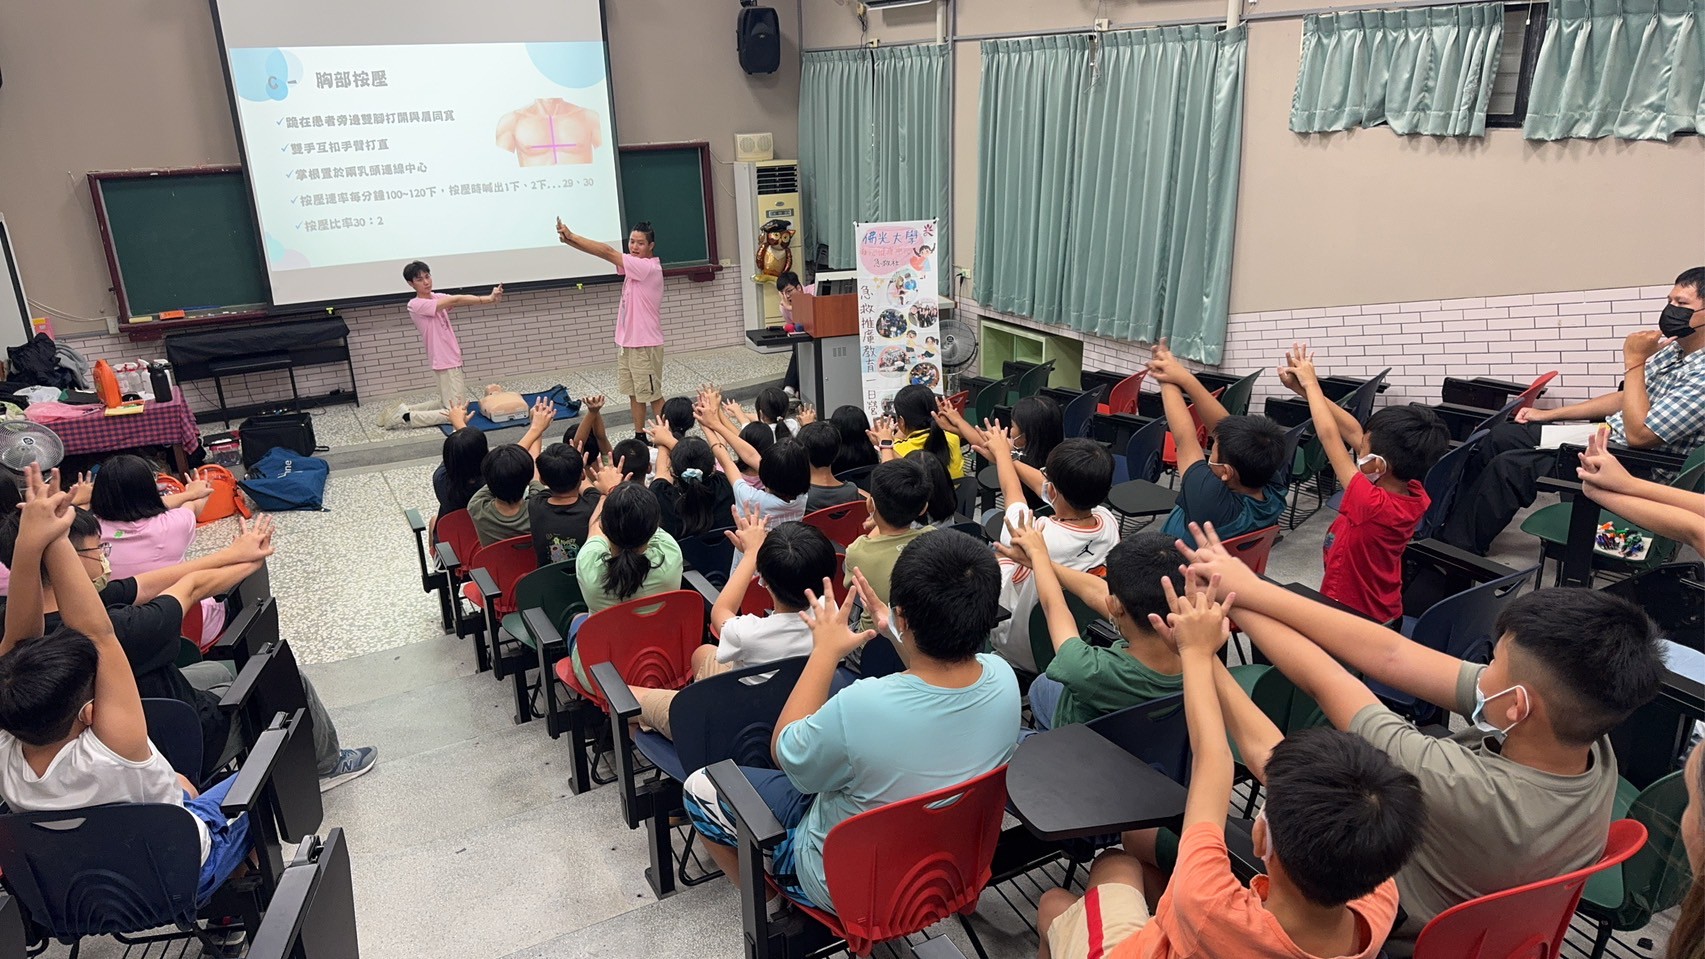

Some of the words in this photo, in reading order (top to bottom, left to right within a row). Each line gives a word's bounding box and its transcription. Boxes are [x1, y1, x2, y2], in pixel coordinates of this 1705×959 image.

[315, 69, 389, 90] 胸部按壓
[290, 138, 390, 155] 雙手互扣手臂打直
[295, 161, 428, 181] 掌根置於兩乳頭連線中心
[862, 229, 919, 245] 佛光大學
[860, 284, 878, 416] 急救推廣教育一日營
